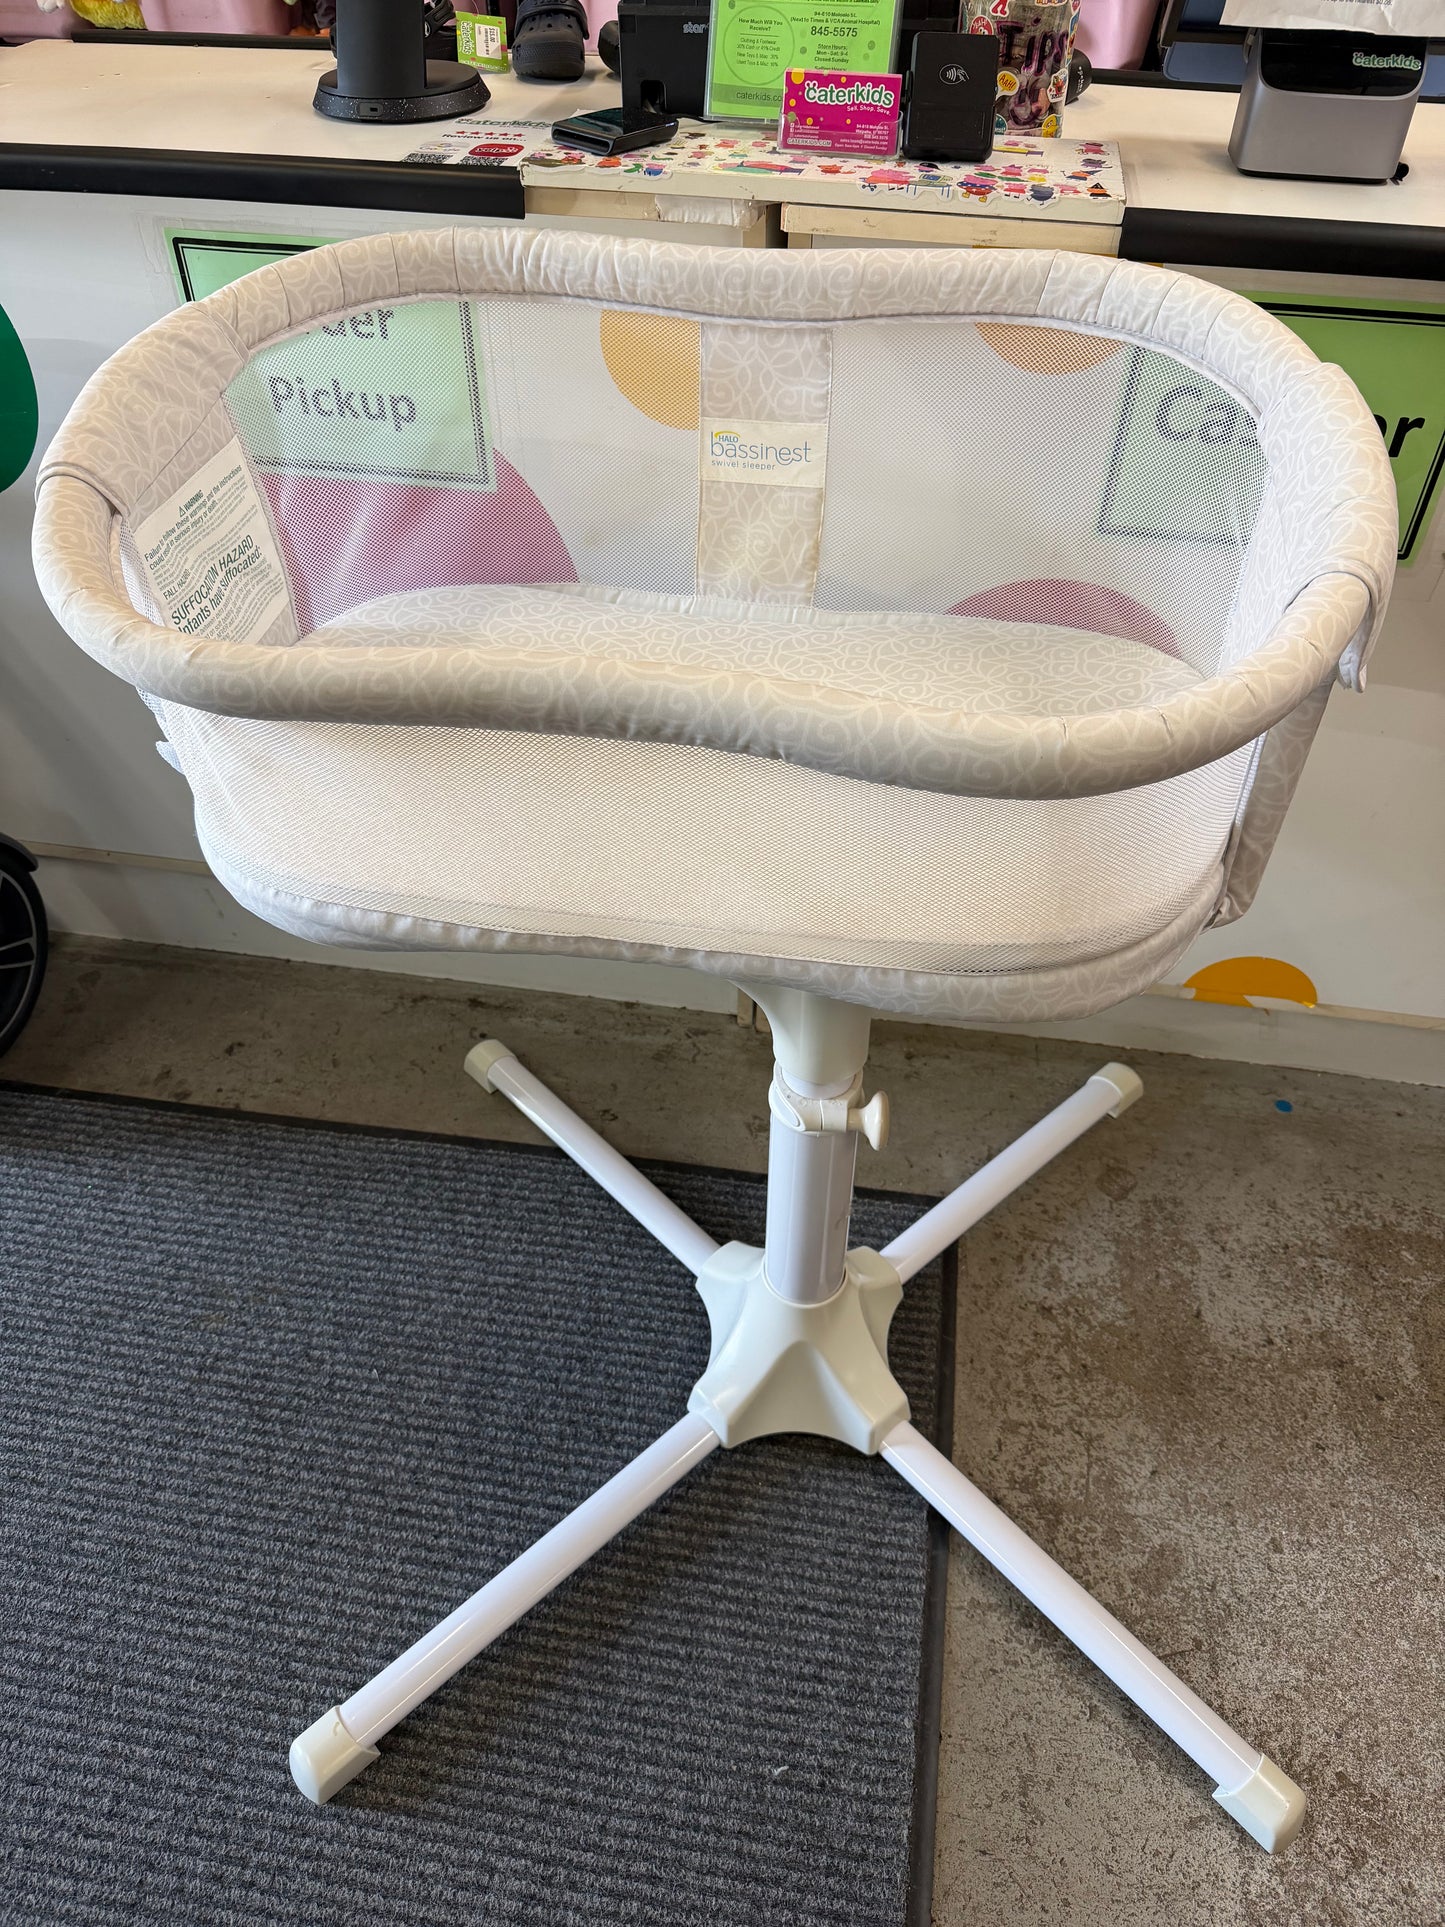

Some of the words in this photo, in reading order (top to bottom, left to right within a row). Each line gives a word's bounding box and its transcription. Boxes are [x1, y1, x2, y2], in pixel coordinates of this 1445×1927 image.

[810, 25, 858, 37] 845-5575
[877, 106, 891, 116] Save.
[268, 376, 417, 432] Pickup
[710, 431, 812, 466] bassinest
[718, 435, 739, 443] HALO
[711, 459, 739, 468] swivel
[742, 461, 775, 471] sleeper
[175, 515, 190, 530] these
[190, 498, 207, 519] warnings
[213, 484, 221, 494] the
[219, 464, 242, 488] instructions
[149, 553, 165, 570] could
[174, 526, 190, 542] serious
[190, 514, 203, 528] injury
[202, 510, 208, 518] or
[171, 563, 219, 625] SUFFOCATION
[218, 534, 254, 572] HAZARD
[163, 585, 178, 600] FALL
[208, 586, 225, 611] have
